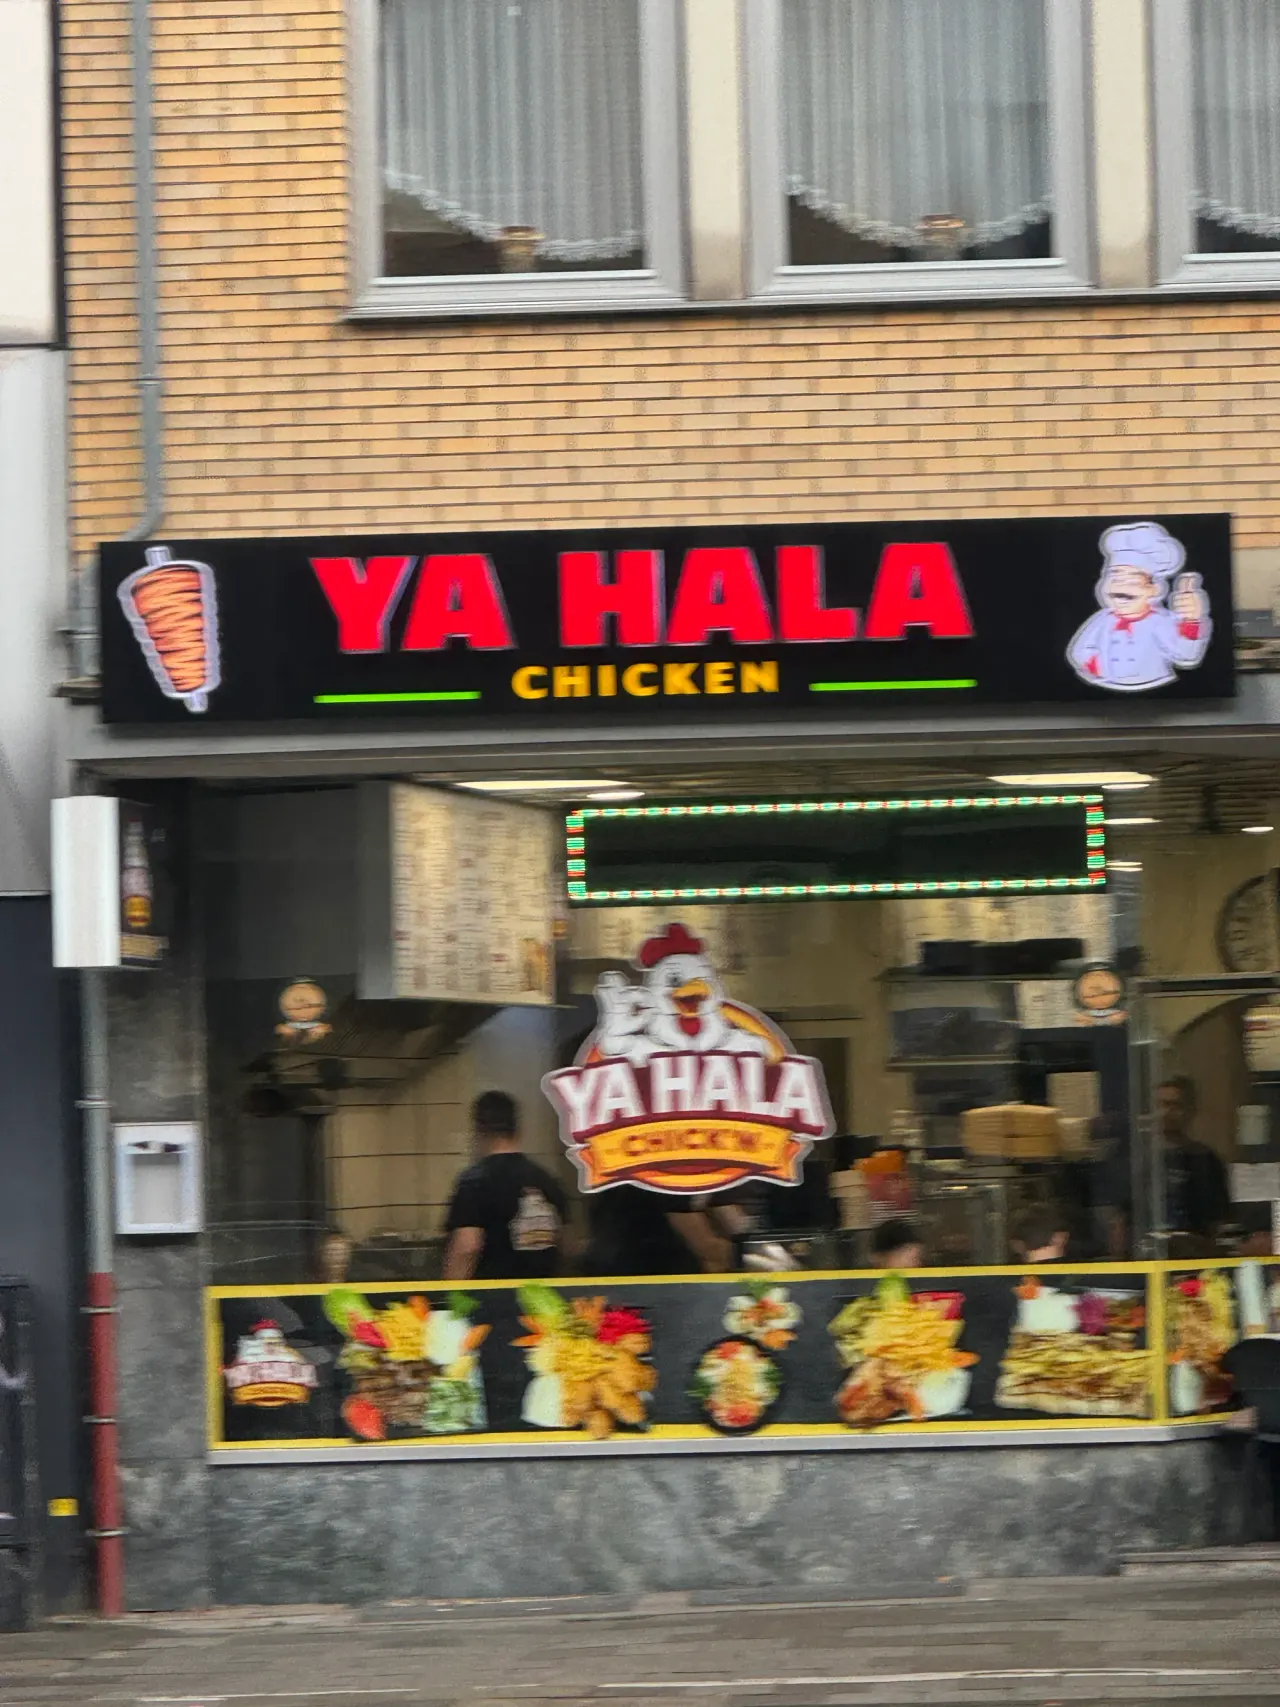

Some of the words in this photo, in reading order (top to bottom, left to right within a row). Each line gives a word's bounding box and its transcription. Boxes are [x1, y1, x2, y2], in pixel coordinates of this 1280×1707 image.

[309, 553, 515, 654] YA
[556, 542, 976, 647] HALA
[511, 661, 781, 700] CHICKEN
[550, 1060, 645, 1134] YA
[649, 1055, 824, 1128] HALA
